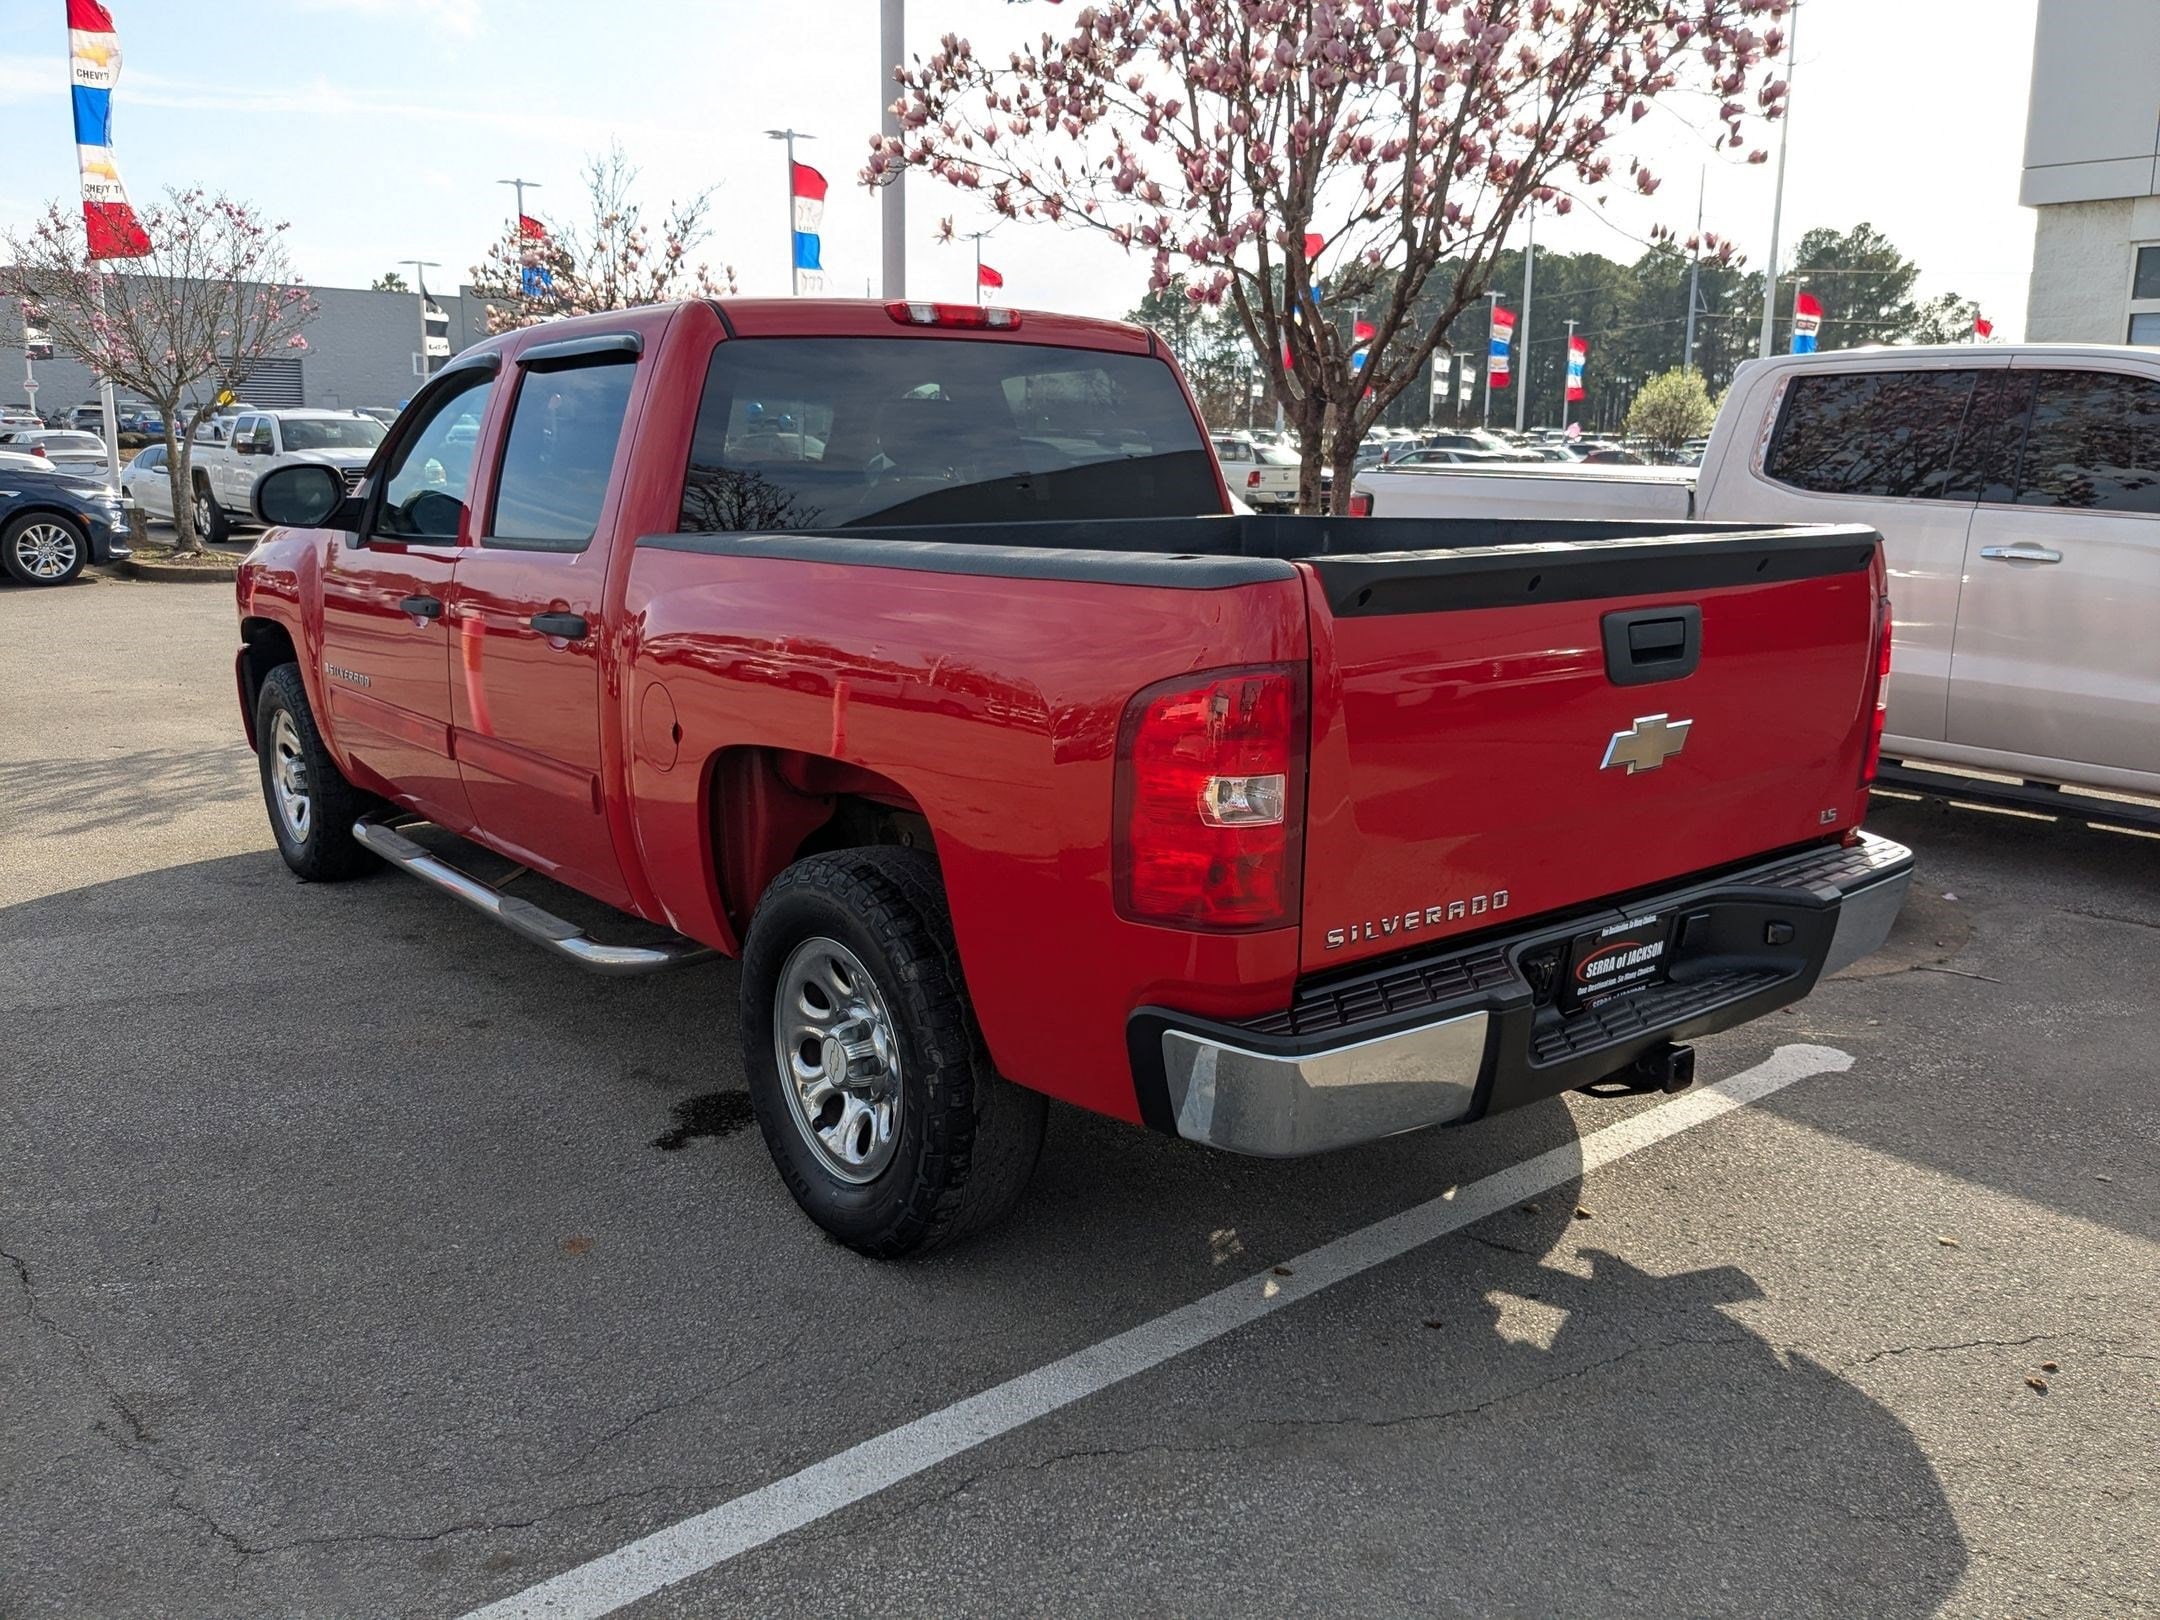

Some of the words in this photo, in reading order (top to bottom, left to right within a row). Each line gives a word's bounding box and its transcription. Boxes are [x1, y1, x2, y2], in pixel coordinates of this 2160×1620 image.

[76, 68, 104, 81] CHEVY
[329, 663, 371, 688] SILVERADO
[1819, 807, 1837, 825] LS
[1326, 889, 1510, 949] SILVERADO
[1585, 956, 1616, 979] SERRA
[1616, 952, 1628, 969] of
[1626, 940, 1664, 966] JACKSON
[1617, 975, 1625, 983] So
[1624, 971, 1637, 980] Many
